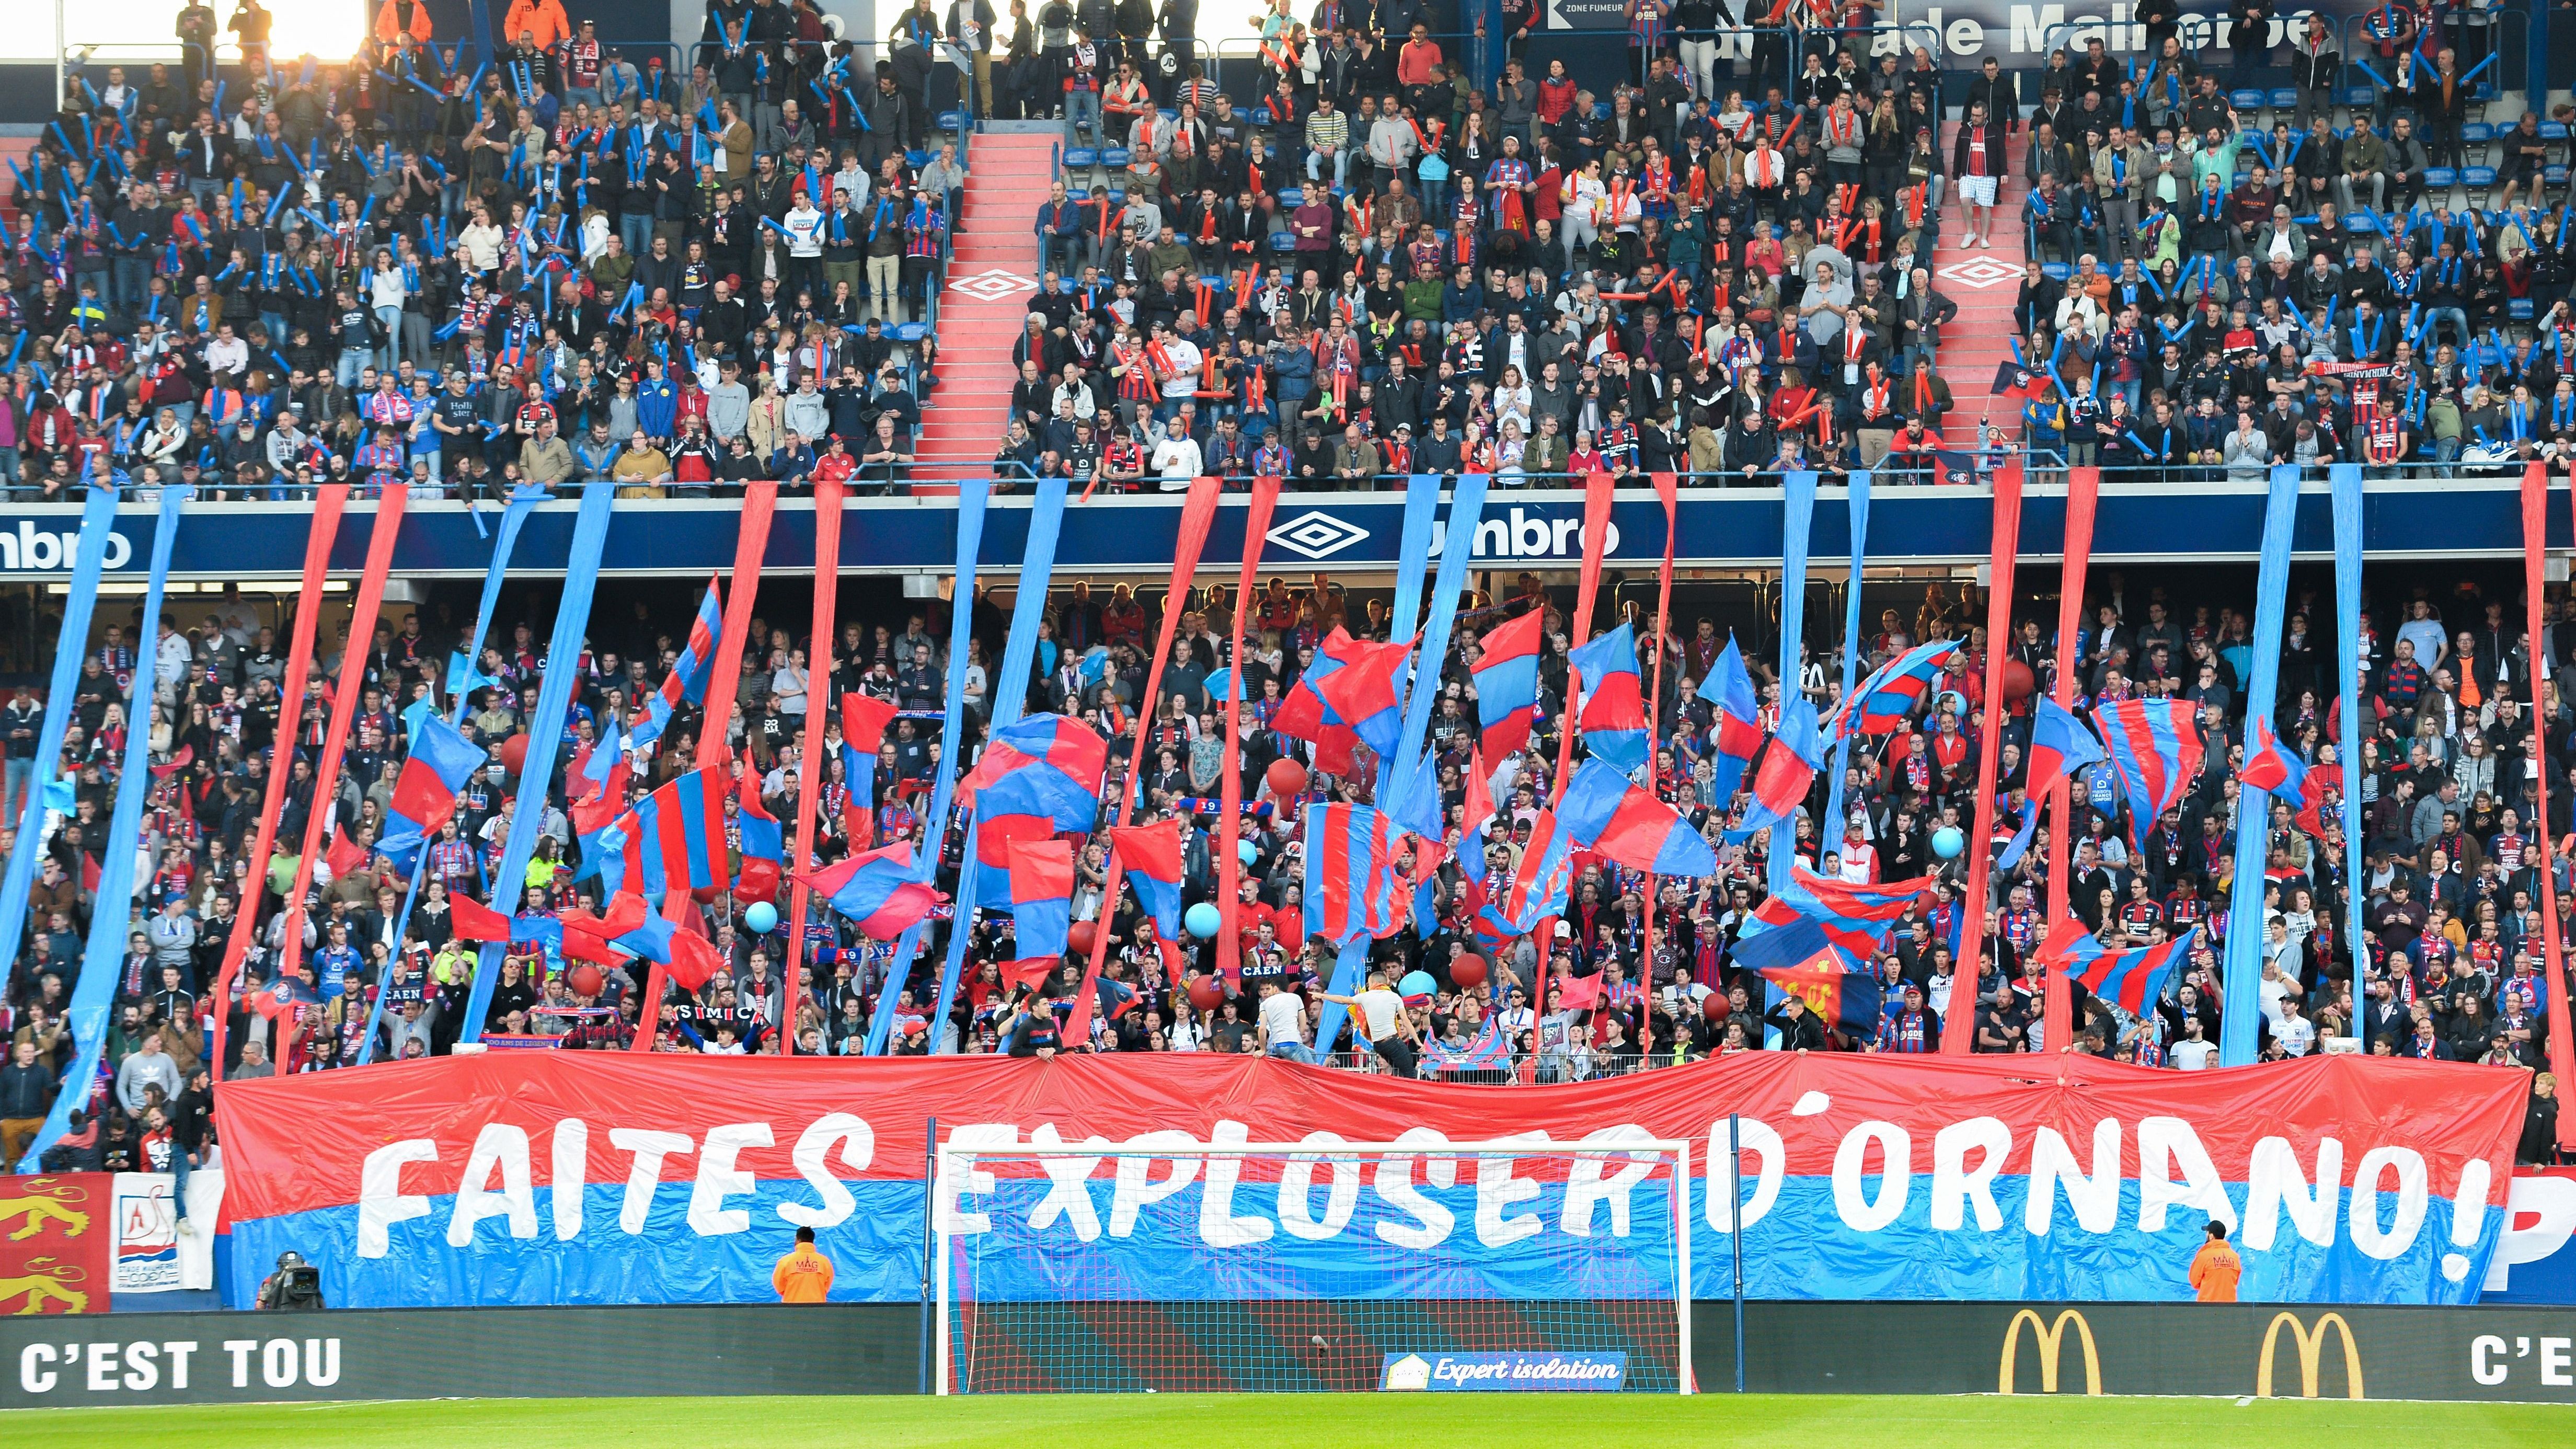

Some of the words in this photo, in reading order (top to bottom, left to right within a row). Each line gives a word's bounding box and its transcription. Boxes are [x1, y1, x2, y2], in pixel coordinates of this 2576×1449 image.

[1163, 58, 1176, 68] JD
[450, 401, 473, 410] Holli
[452, 410, 471, 418] ster
[1201, 801, 1216, 811] 19
[841, 951, 857, 961] 19
[1242, 965, 1283, 977] CAEN
[384, 990, 421, 1000] CAEN
[1907, 1030, 1924, 1039] GDE
[357, 1112, 876, 1259] FAITES
[932, 1119, 1661, 1249] EXPLOSER
[20, 1341, 198, 1393] C'EST
[223, 1338, 341, 1388] TOU
[1433, 1358, 1511, 1387] Expert
[1511, 1356, 1620, 1381] isolation
